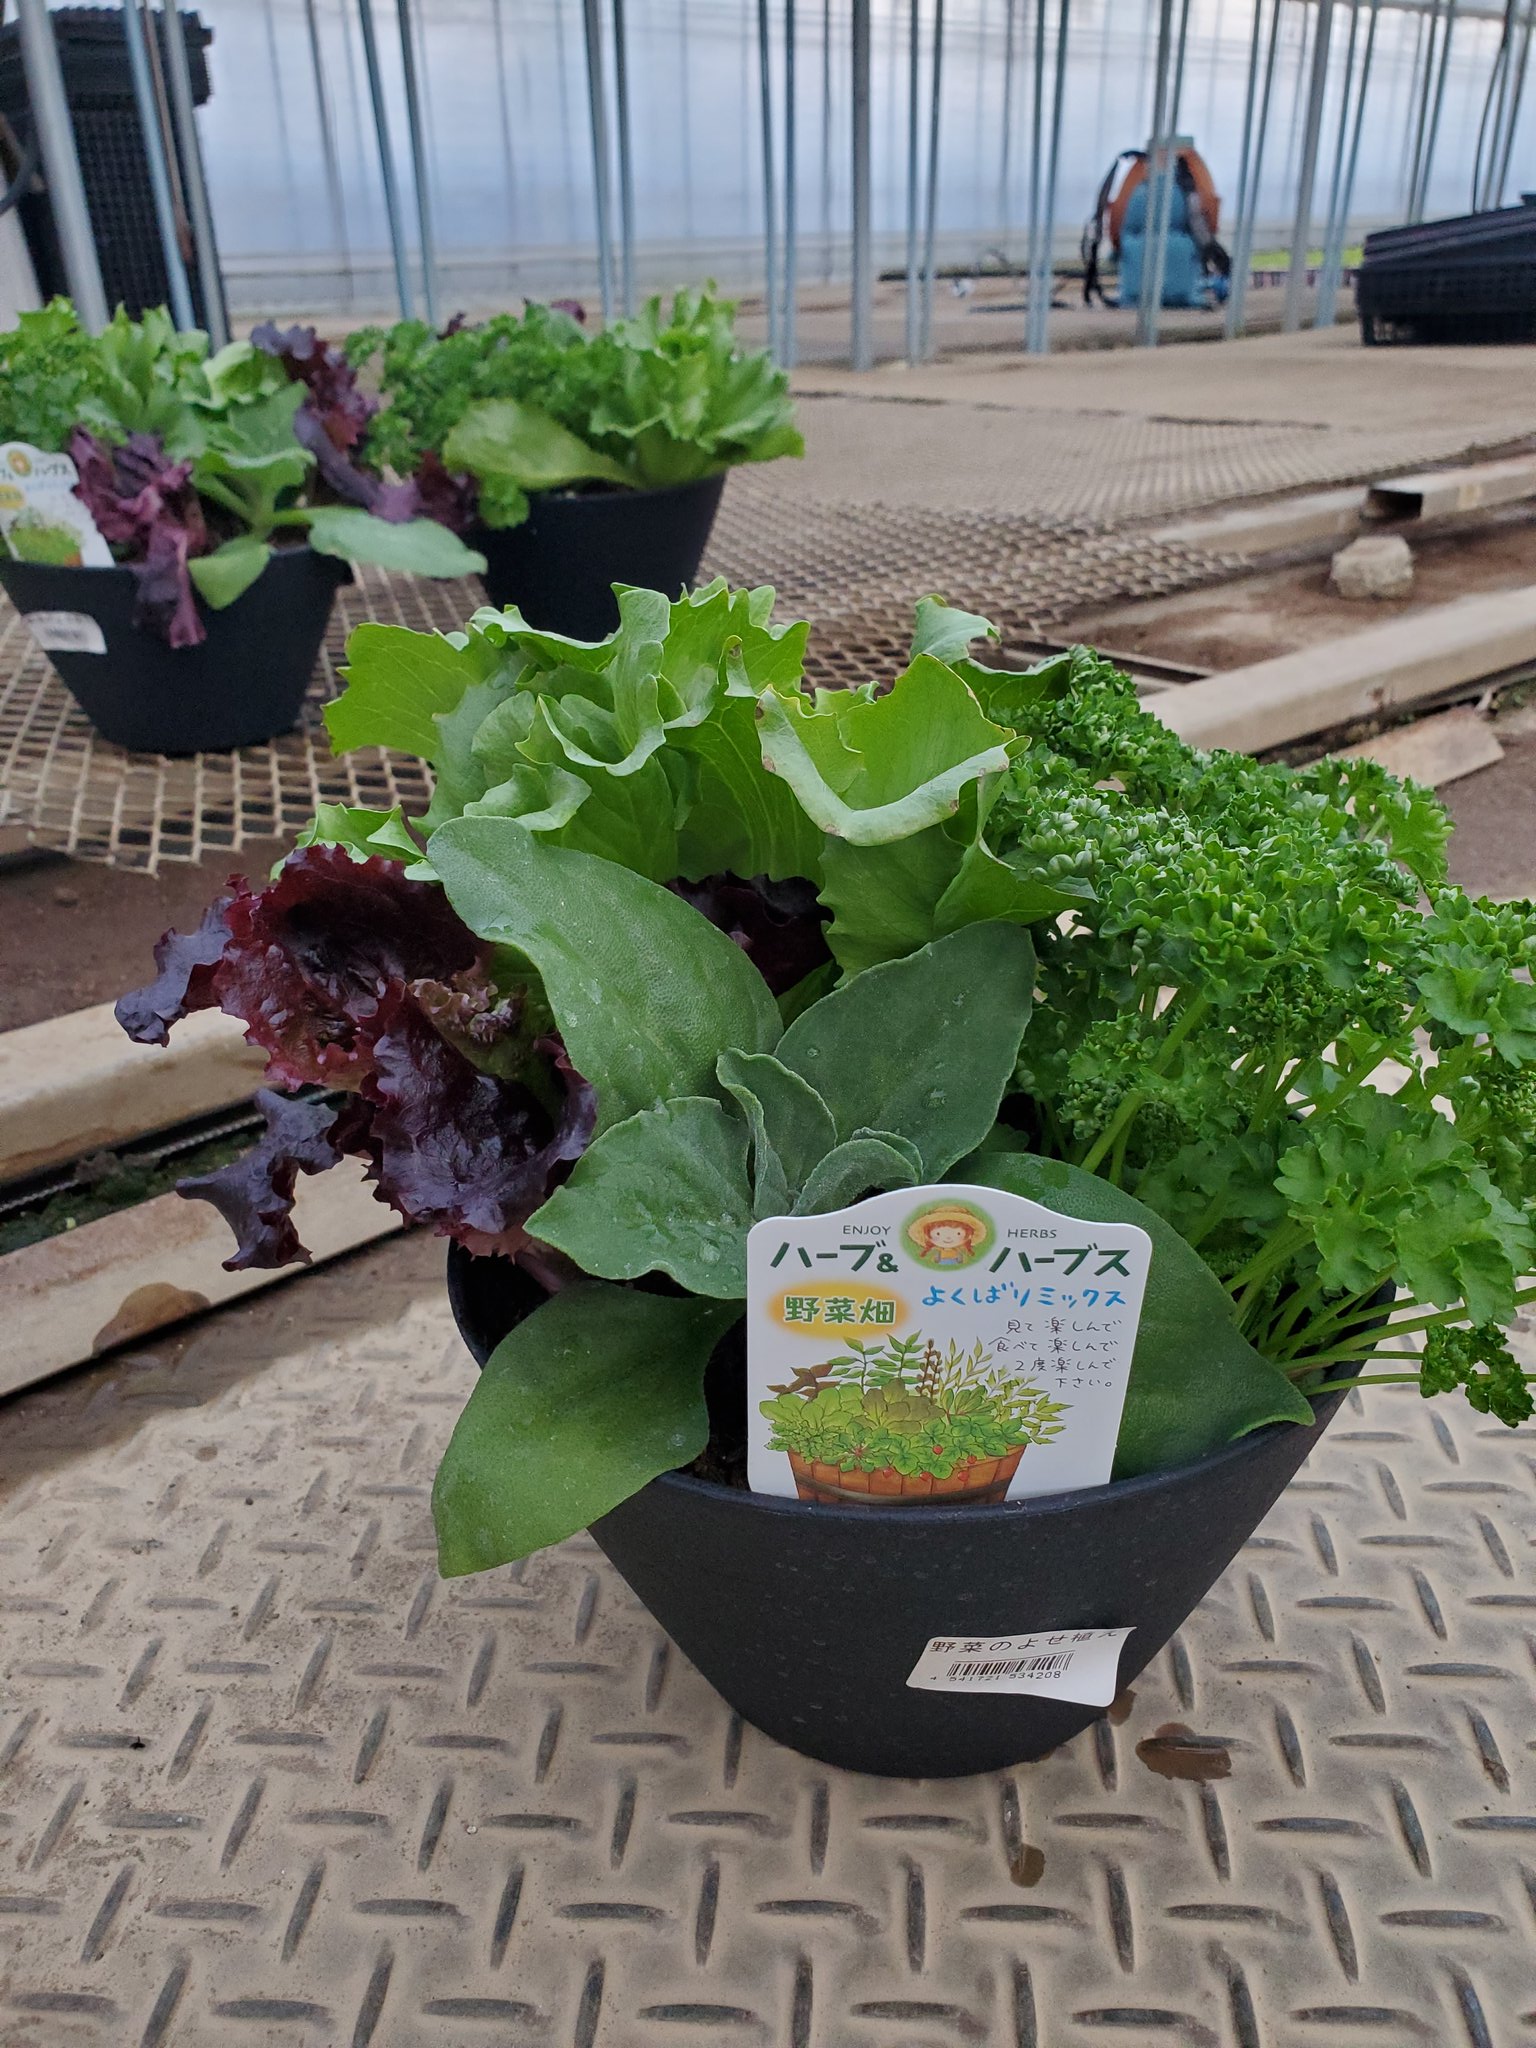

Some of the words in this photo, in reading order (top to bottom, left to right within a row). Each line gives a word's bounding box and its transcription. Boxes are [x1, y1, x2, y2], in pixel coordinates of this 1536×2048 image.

[842, 1224, 892, 1236] ENJOY
[1007, 1228, 1058, 1239] HERBS
[988, 1242, 1131, 1278] ハーブス
[921, 1280, 1127, 1309] よくばりミックス
[783, 1295, 898, 1325] 野菜畑
[929, 1630, 1118, 1654] 野菜のよせ植え
[1008, 1670, 1062, 1680] 534208
